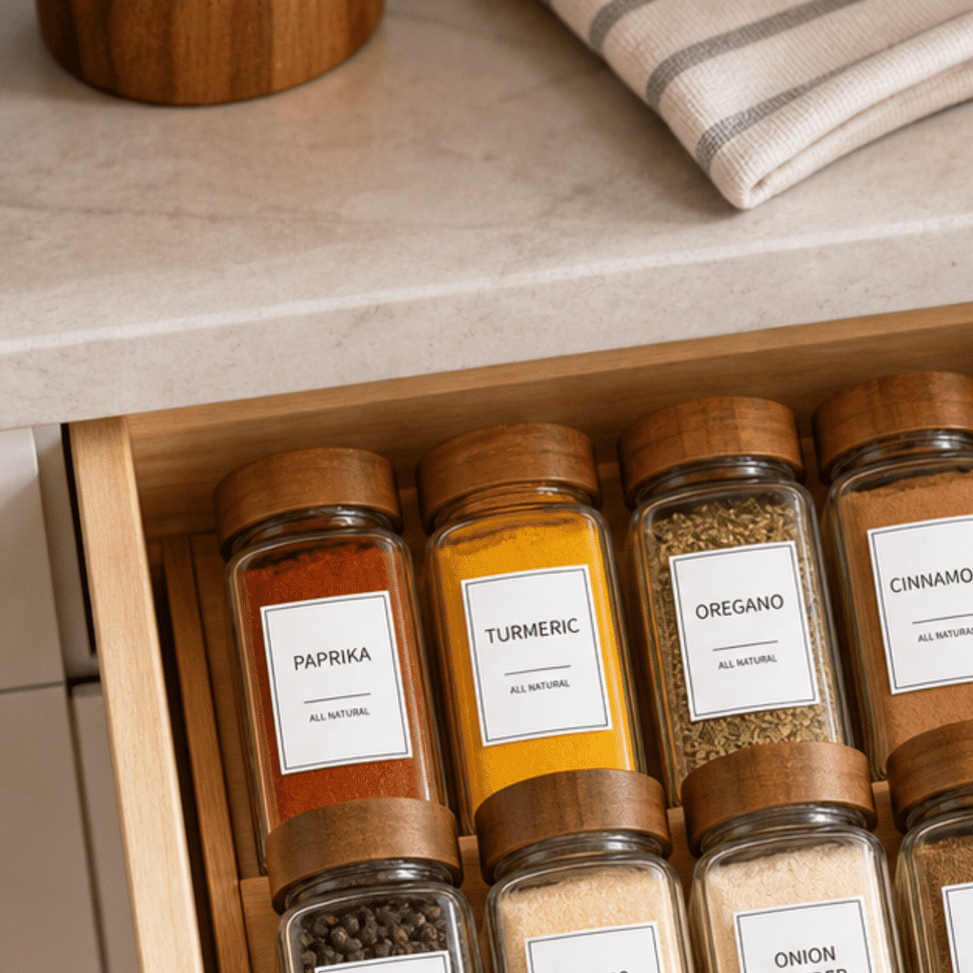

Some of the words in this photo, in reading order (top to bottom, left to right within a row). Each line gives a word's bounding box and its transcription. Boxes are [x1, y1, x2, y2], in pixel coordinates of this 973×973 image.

[695, 593, 784, 620] OREGANO
[484, 617, 580, 644] TURMERIC
[917, 632, 934, 642] ALL
[293, 646, 372, 671] PAPRIKA
[718, 659, 734, 669] ALL
[736, 654, 777, 666] NATURAL
[509, 684, 526, 694] ALL
[528, 679, 570, 691] NATURAL
[309, 712, 326, 722] ALL
[327, 707, 370, 720] NATURAL
[774, 945, 836, 969] ONION
